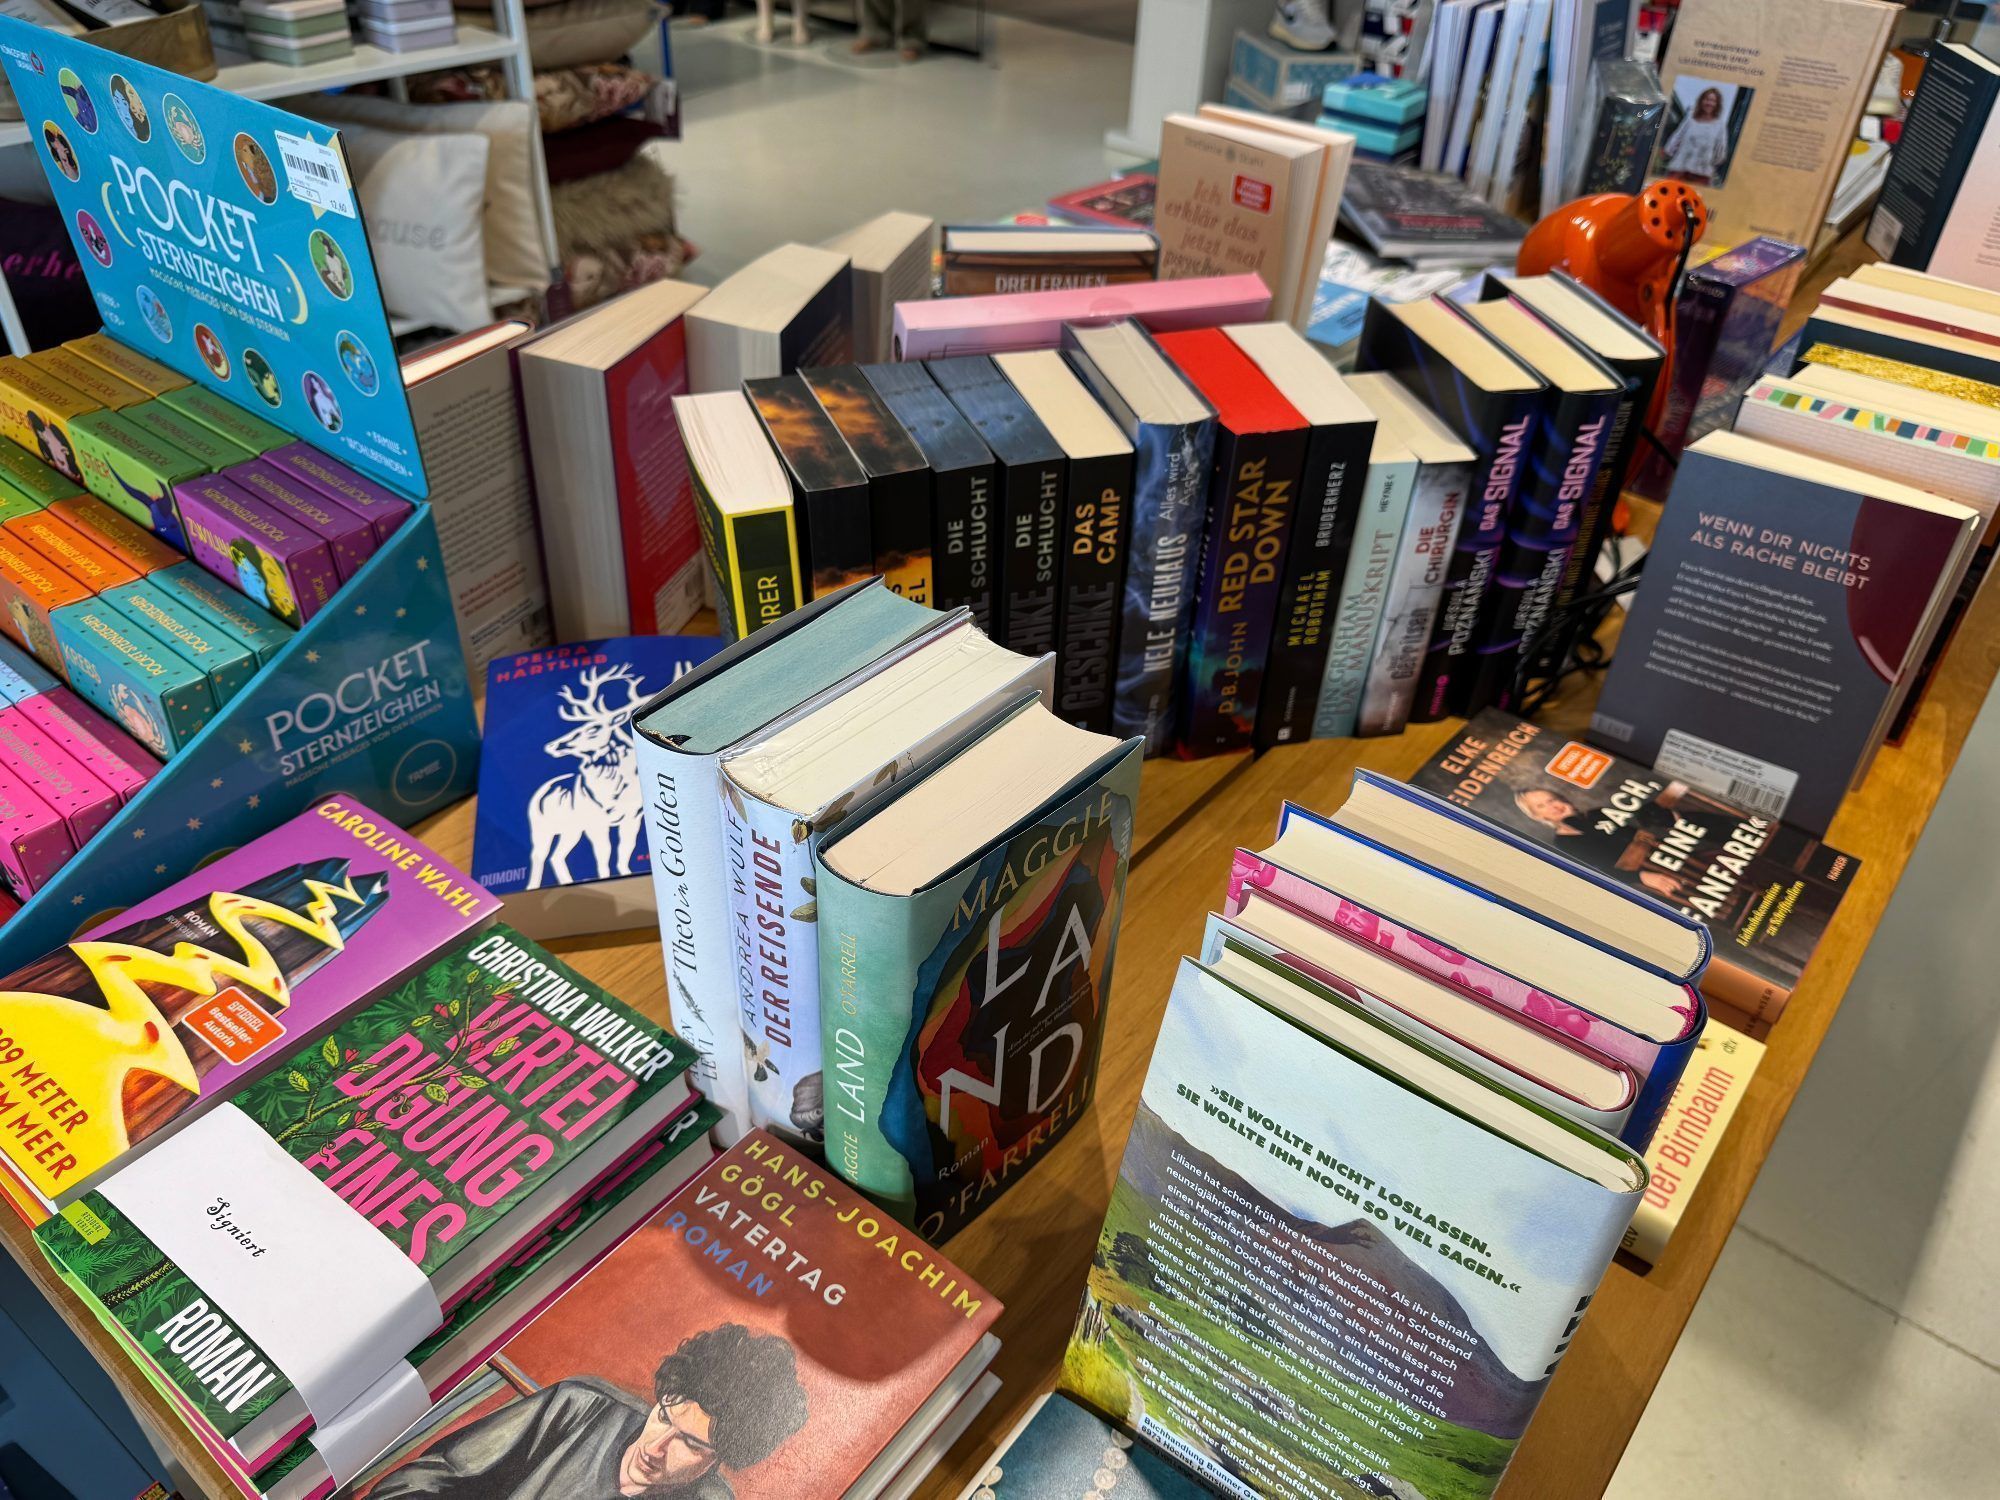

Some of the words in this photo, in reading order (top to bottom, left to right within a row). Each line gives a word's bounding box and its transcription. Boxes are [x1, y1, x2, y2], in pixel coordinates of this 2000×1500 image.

[109, 154, 265, 273] POCKET
[136, 227, 285, 323] STERNZEICHEN
[1166, 451, 1181, 476] wird
[1484, 413, 1531, 501] SIGNAL
[1559, 413, 1607, 500] SIGNAL
[202, 487, 261, 528] STERNZEICHEN
[254, 519, 289, 543] POCKET
[948, 519, 964, 554] DIE
[970, 476, 988, 588] SCHLUCHT
[1015, 513, 1033, 548] DIE
[1036, 471, 1058, 583] SCHLUCHT
[1072, 502, 1096, 556] DAS
[1096, 488, 1121, 564] CAMP
[1159, 477, 1178, 521] Alles
[1229, 456, 1267, 543] STAR
[1250, 479, 1293, 585] DOWN
[1315, 460, 1347, 548] BRUDERHERZ
[1480, 502, 1503, 531] DAS
[1553, 502, 1576, 530] DAS
[29, 523, 78, 560] STERNZEICHEN
[75, 550, 106, 577] POCKET
[1415, 526, 1434, 554] DIE
[1424, 491, 1461, 585] CHIRURGIN
[1690, 531, 1726, 551] ALS
[1730, 541, 1798, 571] RACHE
[1802, 561, 1870, 590] BLEIBT
[1698, 511, 1754, 540] WENN
[1760, 528, 1792, 551] DIR
[1798, 539, 1871, 572] NICHTS
[128, 595, 184, 635] STERNZEICHEN
[1150, 533, 1188, 622] NEUHAUS
[1218, 553, 1250, 615] RED
[1287, 570, 1315, 647] MICHAEL
[1303, 569, 1332, 646] ROBOTHAM
[1348, 529, 1394, 671] MANUSKRIPT
[1448, 548, 1494, 656] POZNANSKI
[79, 614, 138, 659] STERNZEICHEN
[129, 650, 168, 677] POCKET
[176, 626, 214, 654] POCKET
[1062, 582, 1115, 712] GESCHKE
[1143, 627, 1176, 673] NELE
[1328, 594, 1361, 680] GRISHAM
[265, 639, 431, 752] POCKET
[280, 679, 441, 776] STERNZEICHEN
[1339, 673, 1359, 716] DAS
[1440, 735, 1488, 775] ELKE
[1447, 721, 1541, 808] EIDENREICH
[656, 772, 687, 877] Golden
[1595, 776, 1660, 836] »ACH,
[316, 801, 422, 872] CAROLINE
[414, 862, 482, 918] WAHL
[480, 866, 527, 887] DUMONT
[727, 810, 748, 896] WULF
[952, 790, 1113, 932] MAGGIE
[1650, 818, 1708, 873] EINE
[184, 910, 219, 938] ROMAN
[674, 882, 691, 907] in
[751, 828, 788, 988] REISENDE
[672, 906, 698, 974] Theo
[735, 911, 757, 1027] ANDREA
[203, 1020, 236, 1048] Autorin
[226, 1001, 266, 1032] SPIEGEL
[467, 934, 591, 1024] CHRISTINA
[569, 1002, 675, 1083] WALKER
[763, 997, 792, 1048] DER
[11, 1060, 89, 1135] METER
[444, 998, 640, 1142] VERTEI
[698, 1039, 717, 1080] LEVI
[835, 1027, 865, 1124] LAND
[6, 1111, 77, 1182] MEER
[333, 1031, 556, 1208] DIGUNG
[1659, 1065, 1735, 1168] Birnbaum
[843, 1131, 860, 1184] AGGIE
[937, 1136, 990, 1181] Roman
[1176, 1082, 1200, 1106] SIE
[1201, 1099, 1267, 1149] WOLLTE
[1268, 1142, 1303, 1171] IHM
[1305, 1165, 1359, 1205] NOCH
[1362, 1198, 1389, 1223] SO
[1391, 1214, 1434, 1249] VIEL
[1437, 1238, 1522, 1299] SAGEN.«
[1209, 1083, 1244, 1113] »SIE
[1244, 1105, 1314, 1156] WOLLTE
[1315, 1149, 1374, 1192] NICHT
[1377, 1182, 1494, 1261] LOSLASSEN.
[75, 1218, 95, 1239] VERLAG
[81, 1210, 104, 1233] RESIDENZ
[206, 1196, 268, 1258] Signiert
[719, 1162, 798, 1231] GÖGL
[743, 1138, 984, 1320] HANS-JOACHIM
[663, 1209, 775, 1299] ROMAN
[694, 1186, 848, 1308] VATERTAG
[1165, 1165, 1242, 1222] neunzigjähriger
[1241, 1214, 1271, 1239] Vater
[1271, 1233, 1290, 1251] auf
[1290, 1246, 1324, 1273] einem
[1325, 1267, 1393, 1317] Wanderweg
[1394, 1308, 1406, 1322] in
[1407, 1315, 1472, 1363] Schottland
[1166, 1181, 1194, 1206] einen
[1194, 1200, 1252, 1244] Herzinfarkt
[1251, 1238, 1296, 1273] erleidet,
[1297, 1267, 1317, 1286] will
[1317, 1280, 1335, 1297] sie
[1335, 1292, 1355, 1310] nur
[1356, 1304, 1384, 1328] eins:
[1385, 1321, 1404, 1340] ihn
[1405, 1333, 1428, 1354] heil
[1428, 1347, 1458, 1372] nach
[1170, 1149, 1203, 1177] Liliane
[1203, 1170, 1220, 1189] hat
[1221, 1184, 1253, 1210] schon
[1253, 1204, 1276, 1225] früh
[1277, 1218, 1299, 1239] ihre
[1300, 1234, 1338, 1264] Mutter
[1338, 1257, 1390, 1295] verloren.
[1390, 1288, 1411, 1307] Als
[1411, 1300, 1429, 1318] ihr
[1429, 1310, 1479, 1348] beinahe
[155, 1298, 273, 1415] ROMAN
[1141, 1424, 1163, 1444] 6973
[1144, 1416, 1206, 1466] Buchhandlung
[1206, 1459, 1243, 1494] Brunner
